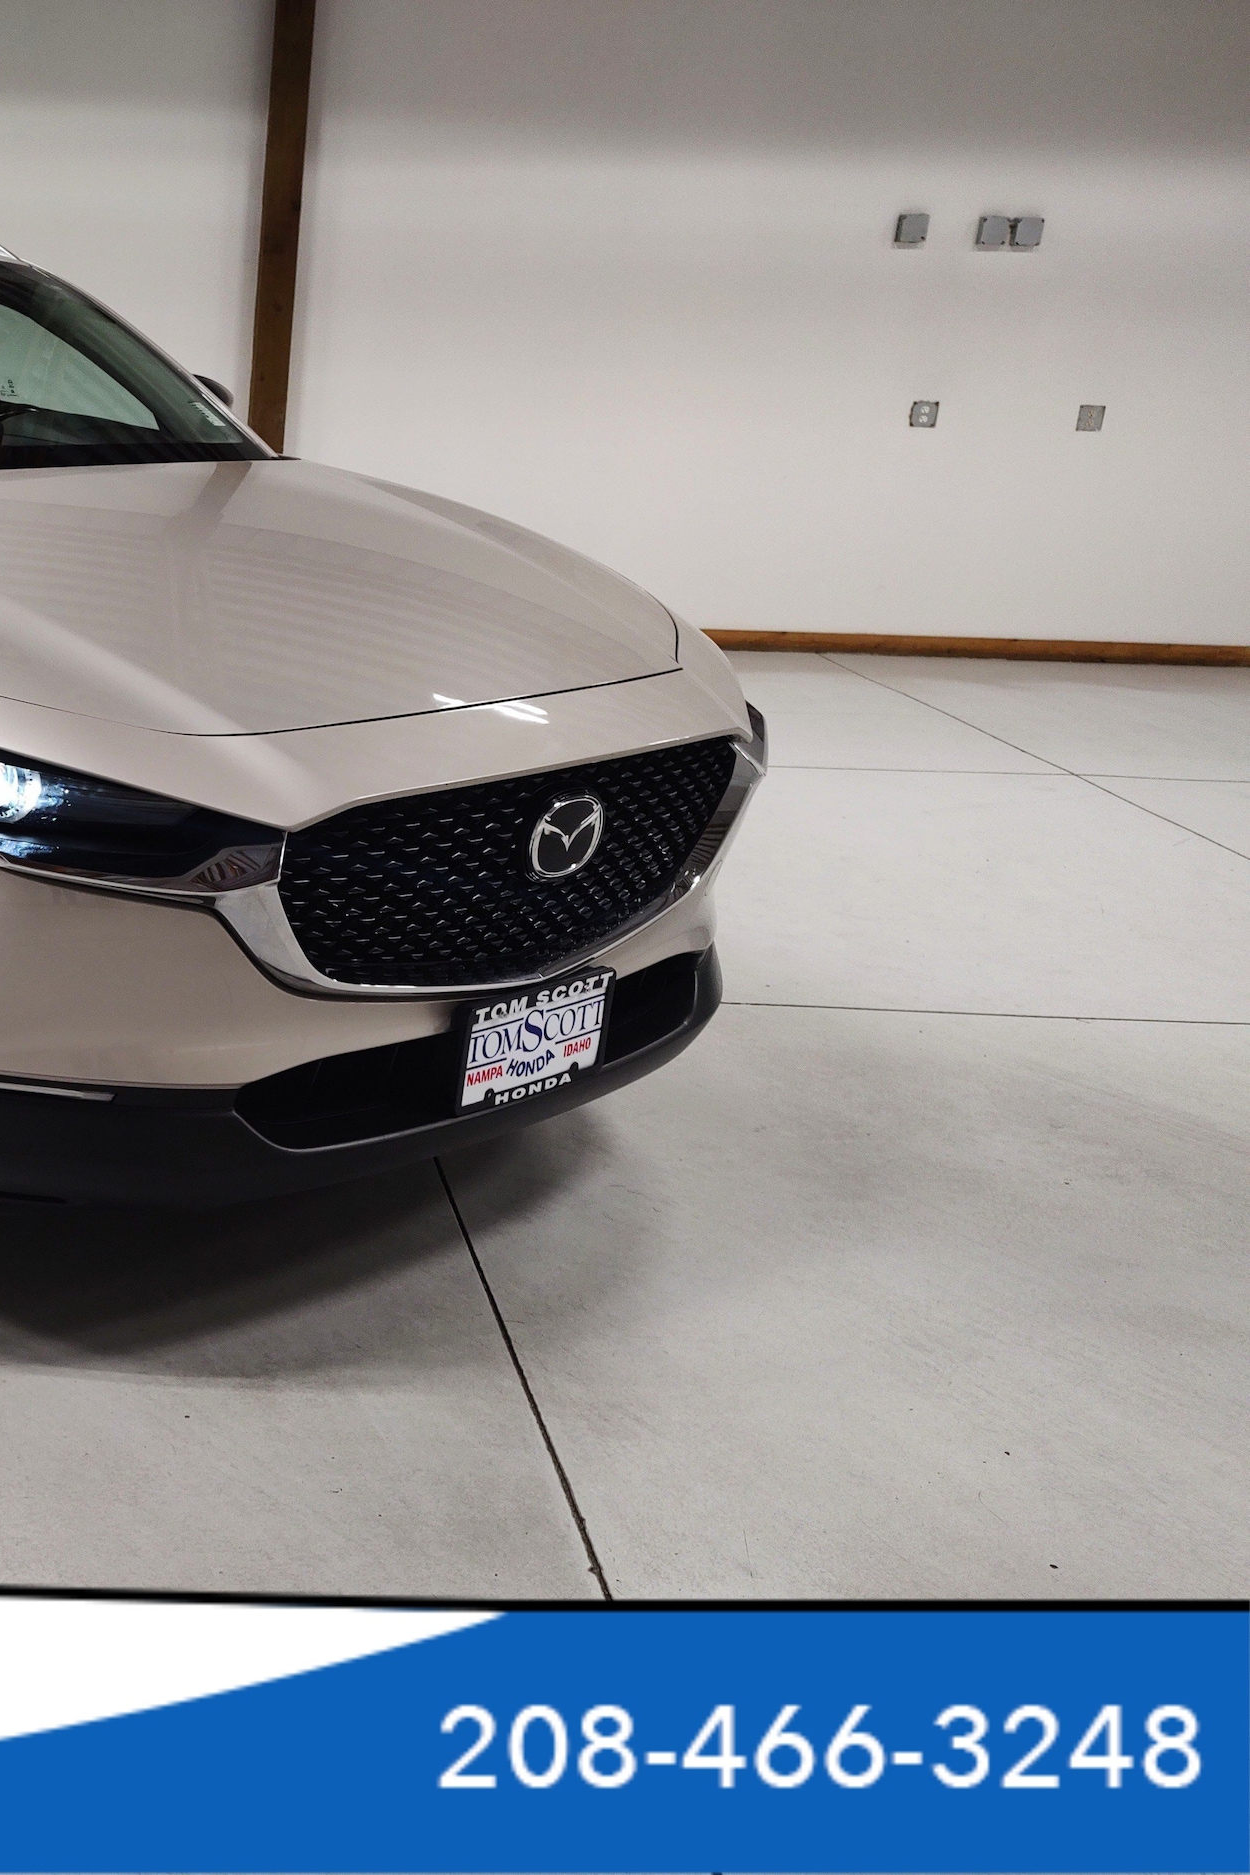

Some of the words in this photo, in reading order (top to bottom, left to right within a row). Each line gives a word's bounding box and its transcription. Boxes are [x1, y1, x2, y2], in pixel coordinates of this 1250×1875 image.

[475, 996, 529, 1024] TOM
[535, 971, 614, 1007] SCOTT
[563, 1037, 591, 1058] IDAHO
[466, 1065, 503, 1087] NAMPA
[506, 1049, 555, 1077] HONDA
[494, 1072, 572, 1105] HONDA
